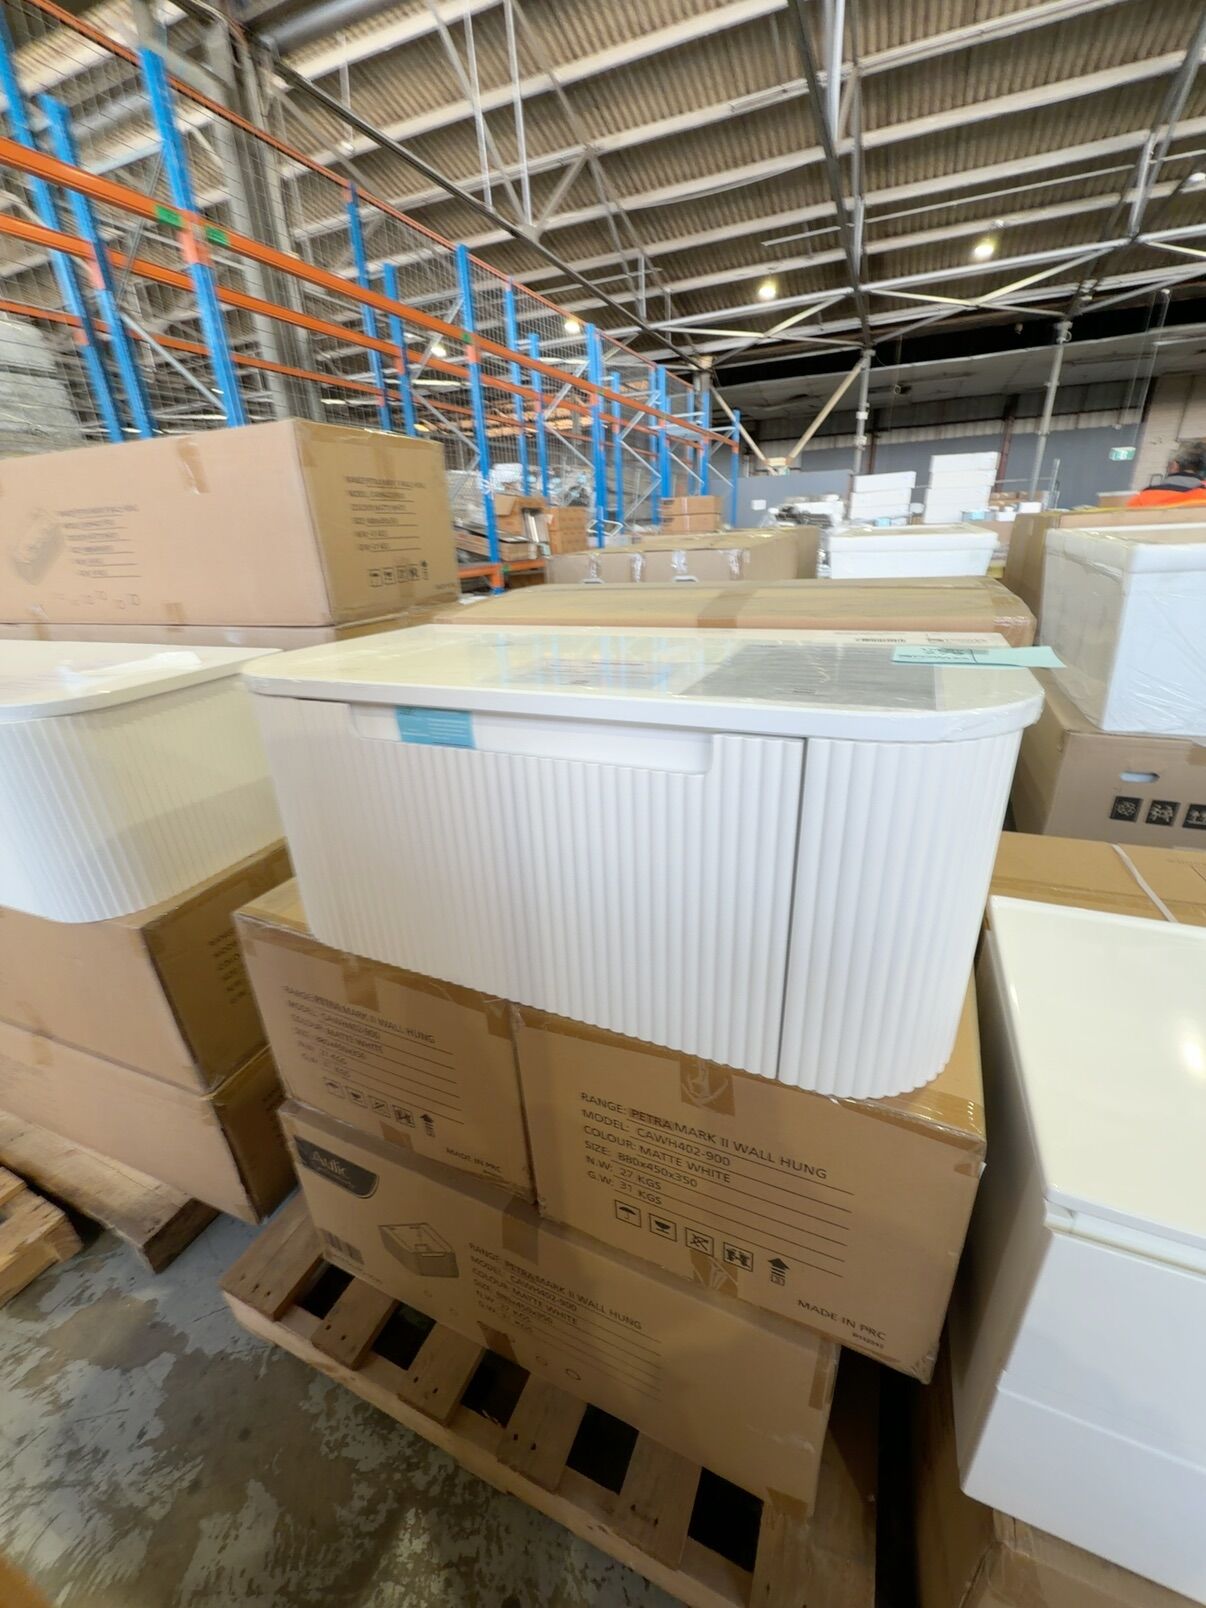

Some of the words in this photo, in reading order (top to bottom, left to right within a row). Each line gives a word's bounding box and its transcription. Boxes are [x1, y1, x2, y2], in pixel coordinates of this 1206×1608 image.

[581, 1092, 627, 1115] RANGE:
[733, 1140, 777, 1164] WALL
[780, 1155, 828, 1180] HUNG
[581, 1109, 631, 1133] MODEL:
[637, 1127, 731, 1167] CAWH402-900
[583, 1125, 637, 1150] COLOUR:
[640, 1145, 683, 1167] MATTE
[686, 1160, 731, 1184] WHITE
[620, 1168, 634, 1179] 27
[638, 1176, 662, 1191] KGS
[620, 1181, 633, 1193] 31
[638, 1190, 663, 1206] KGS
[578, 1295, 606, 1314] WALL
[609, 1308, 642, 1330] HUNG
[797, 1299, 839, 1321] MADE
[842, 1316, 856, 1329] IN
[860, 1323, 887, 1341] PRC
